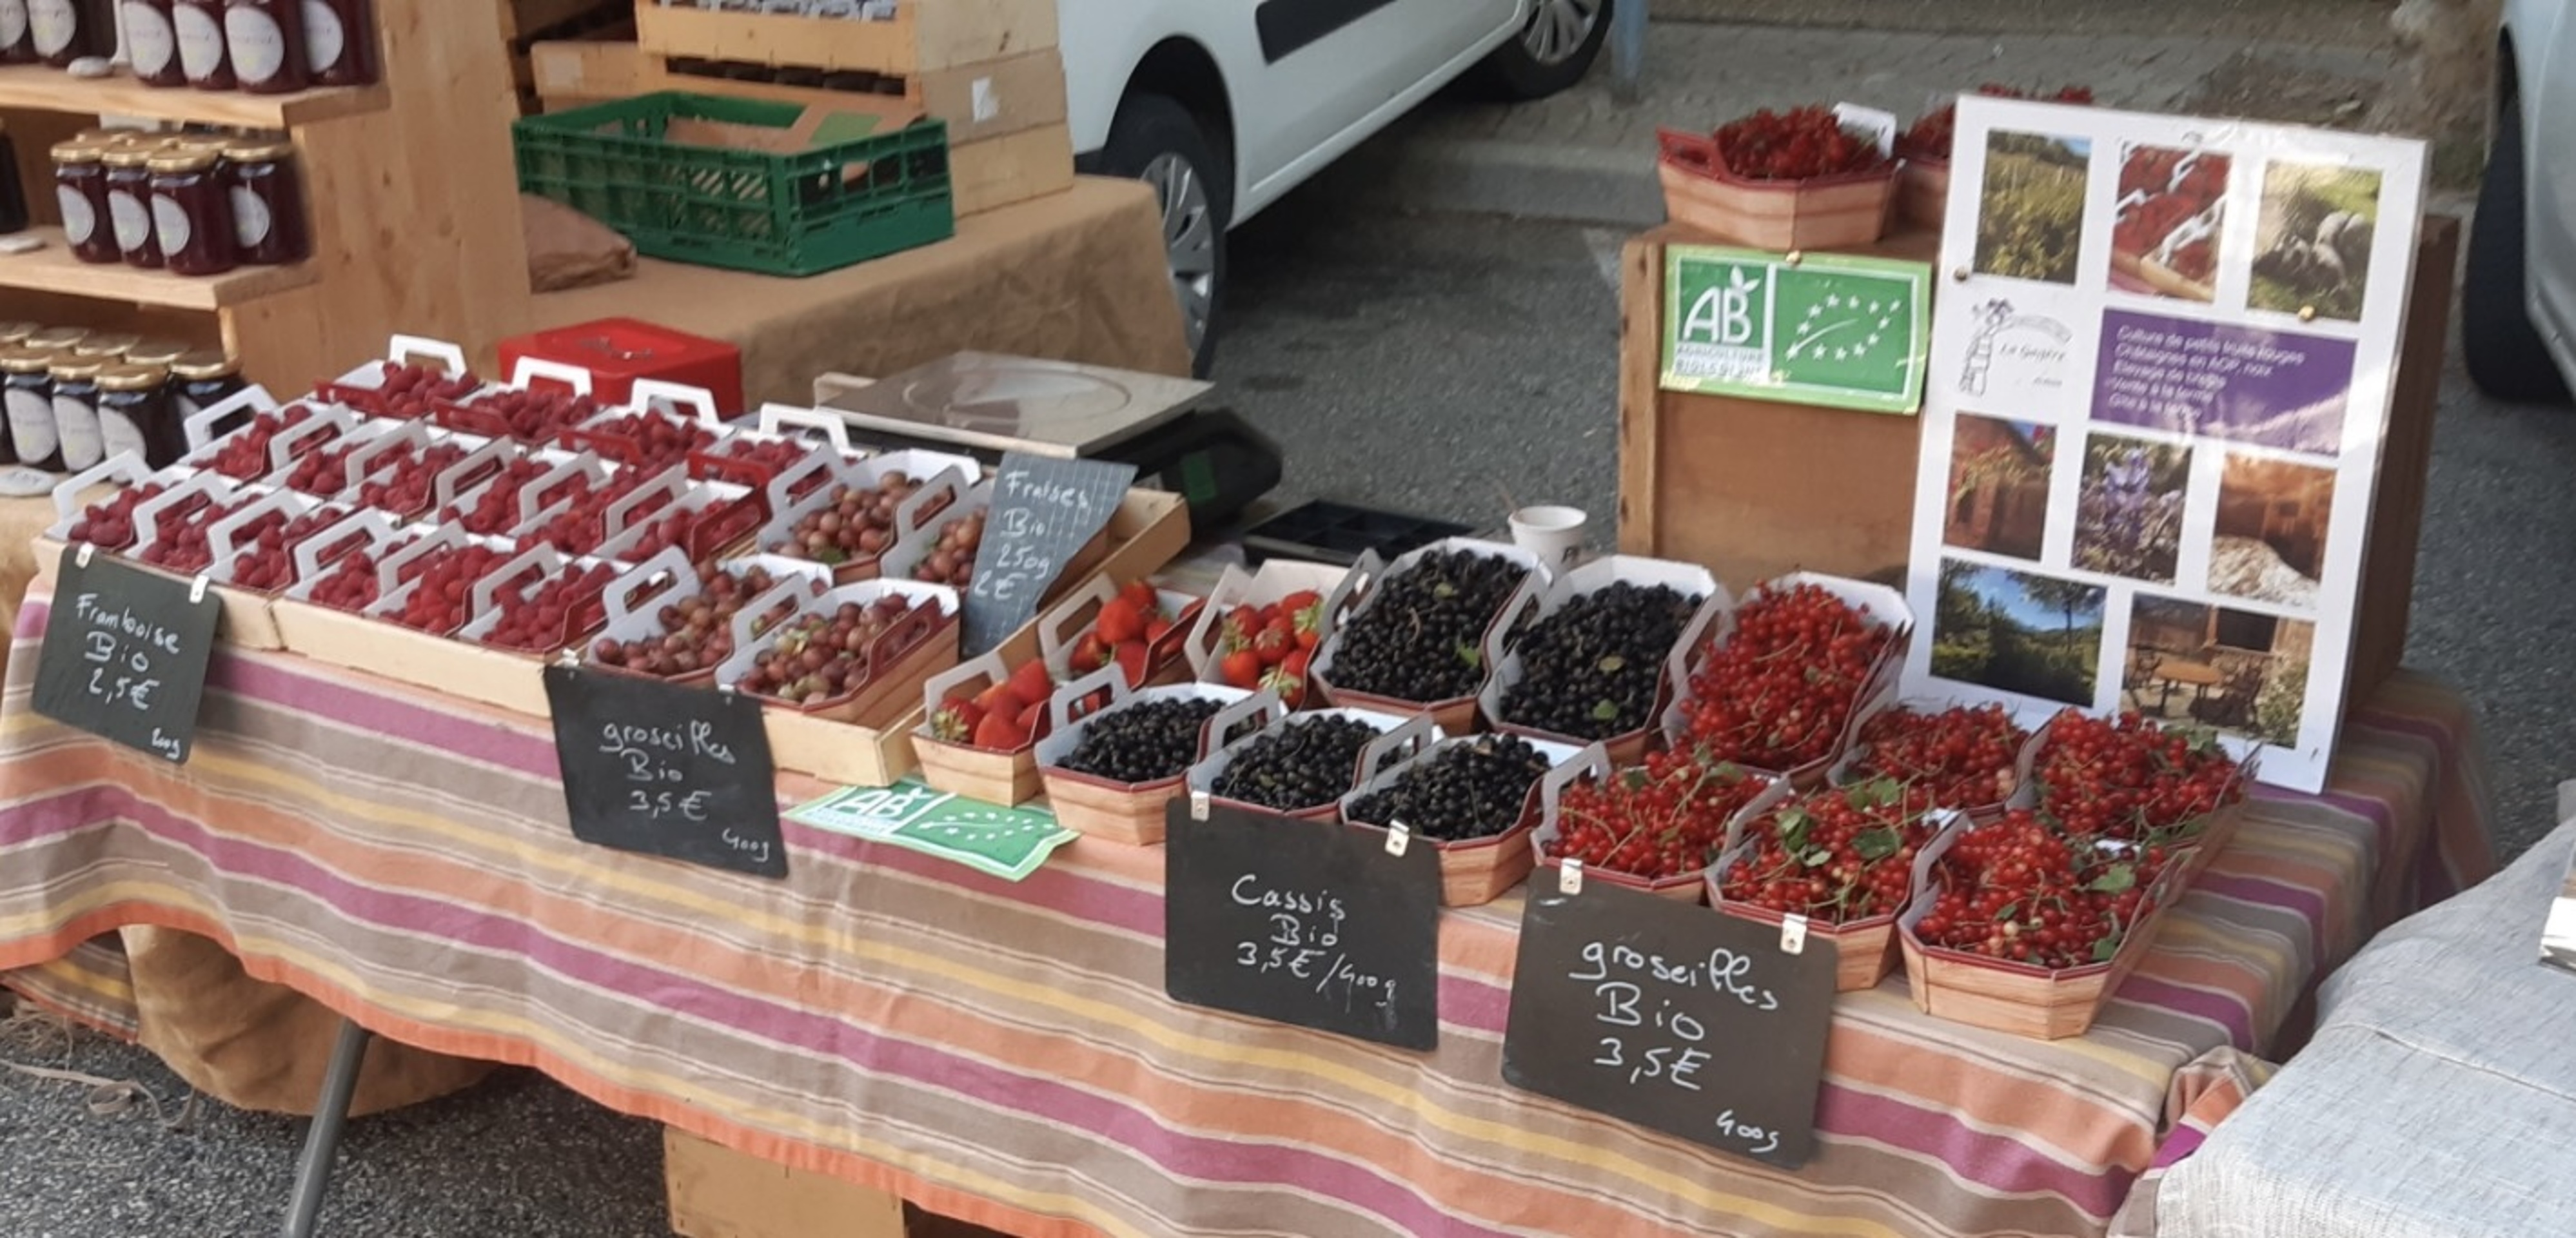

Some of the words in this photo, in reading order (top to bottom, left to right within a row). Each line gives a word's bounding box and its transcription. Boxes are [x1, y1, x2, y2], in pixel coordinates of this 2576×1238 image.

[1683, 285, 1753, 344] AB
[1005, 469, 1088, 509] Fraises
[1000, 507, 1046, 538] Bio
[996, 544, 1051, 580] 250g
[76, 593, 180, 654] Framboise
[84, 631, 150, 672] Bio
[88, 667, 160, 710] 2,5€
[598, 720, 736, 764] groseilles
[620, 748, 683, 781] Bio
[629, 791, 712, 821] 3,5€
[831, 790, 914, 818] AB
[722, 827, 770, 863] 400g
[1231, 874, 1346, 921] Cassis
[1270, 913, 1338, 946] Bio
[1568, 941, 1778, 1010] groseilles
[1595, 981, 1705, 1041] Bio
[1594, 1038, 1711, 1090] 3,5€
[1716, 1109, 1780, 1154] 400g
